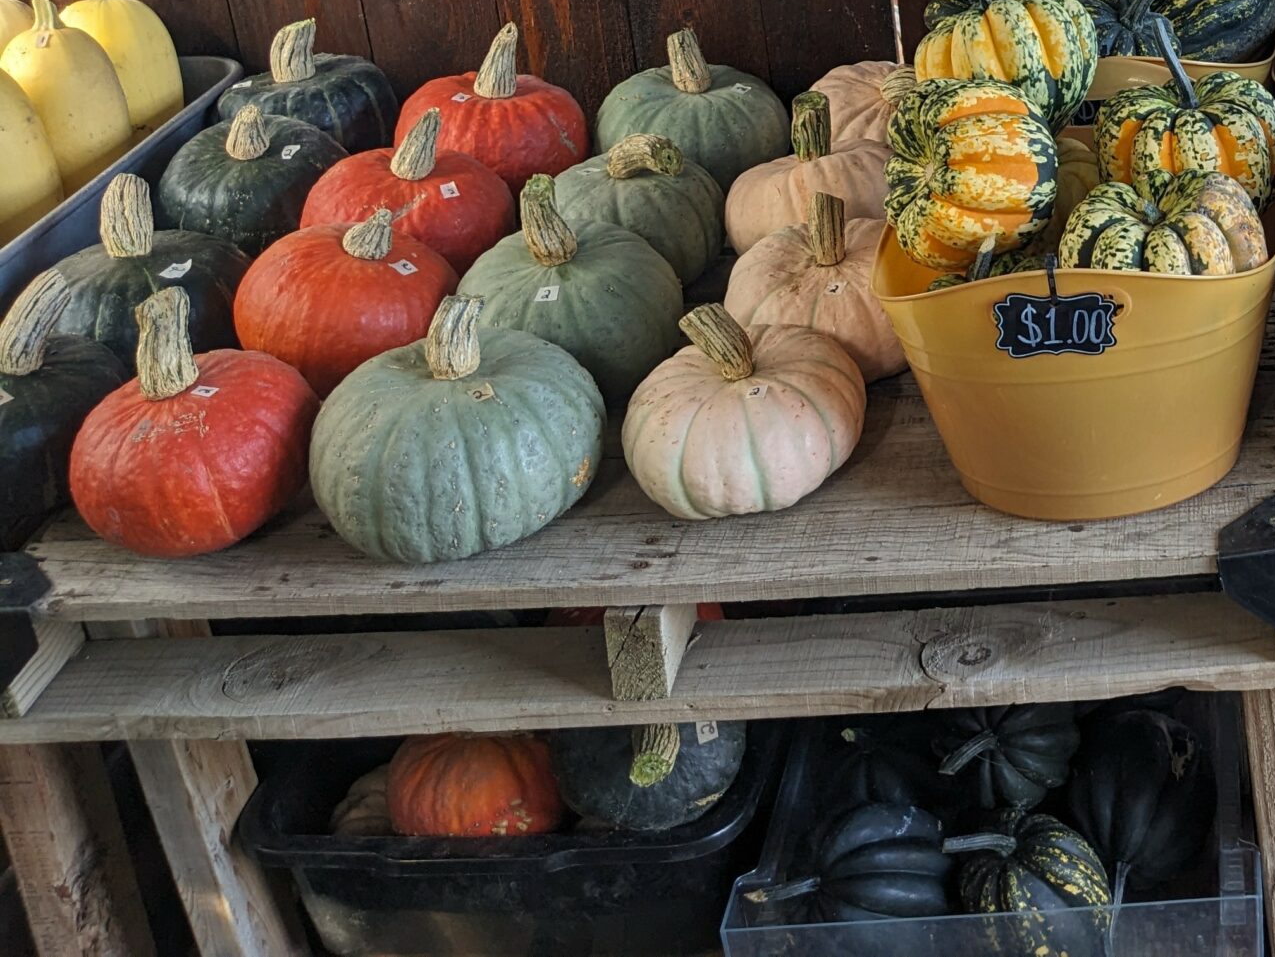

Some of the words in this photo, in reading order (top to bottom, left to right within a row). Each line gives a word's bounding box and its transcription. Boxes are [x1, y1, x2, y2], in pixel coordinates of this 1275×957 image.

[284, 148, 293, 157] 2
[541, 289, 551, 299] 2
[1017, 303, 1109, 346] $1.00
[749, 387, 760, 396] 2
